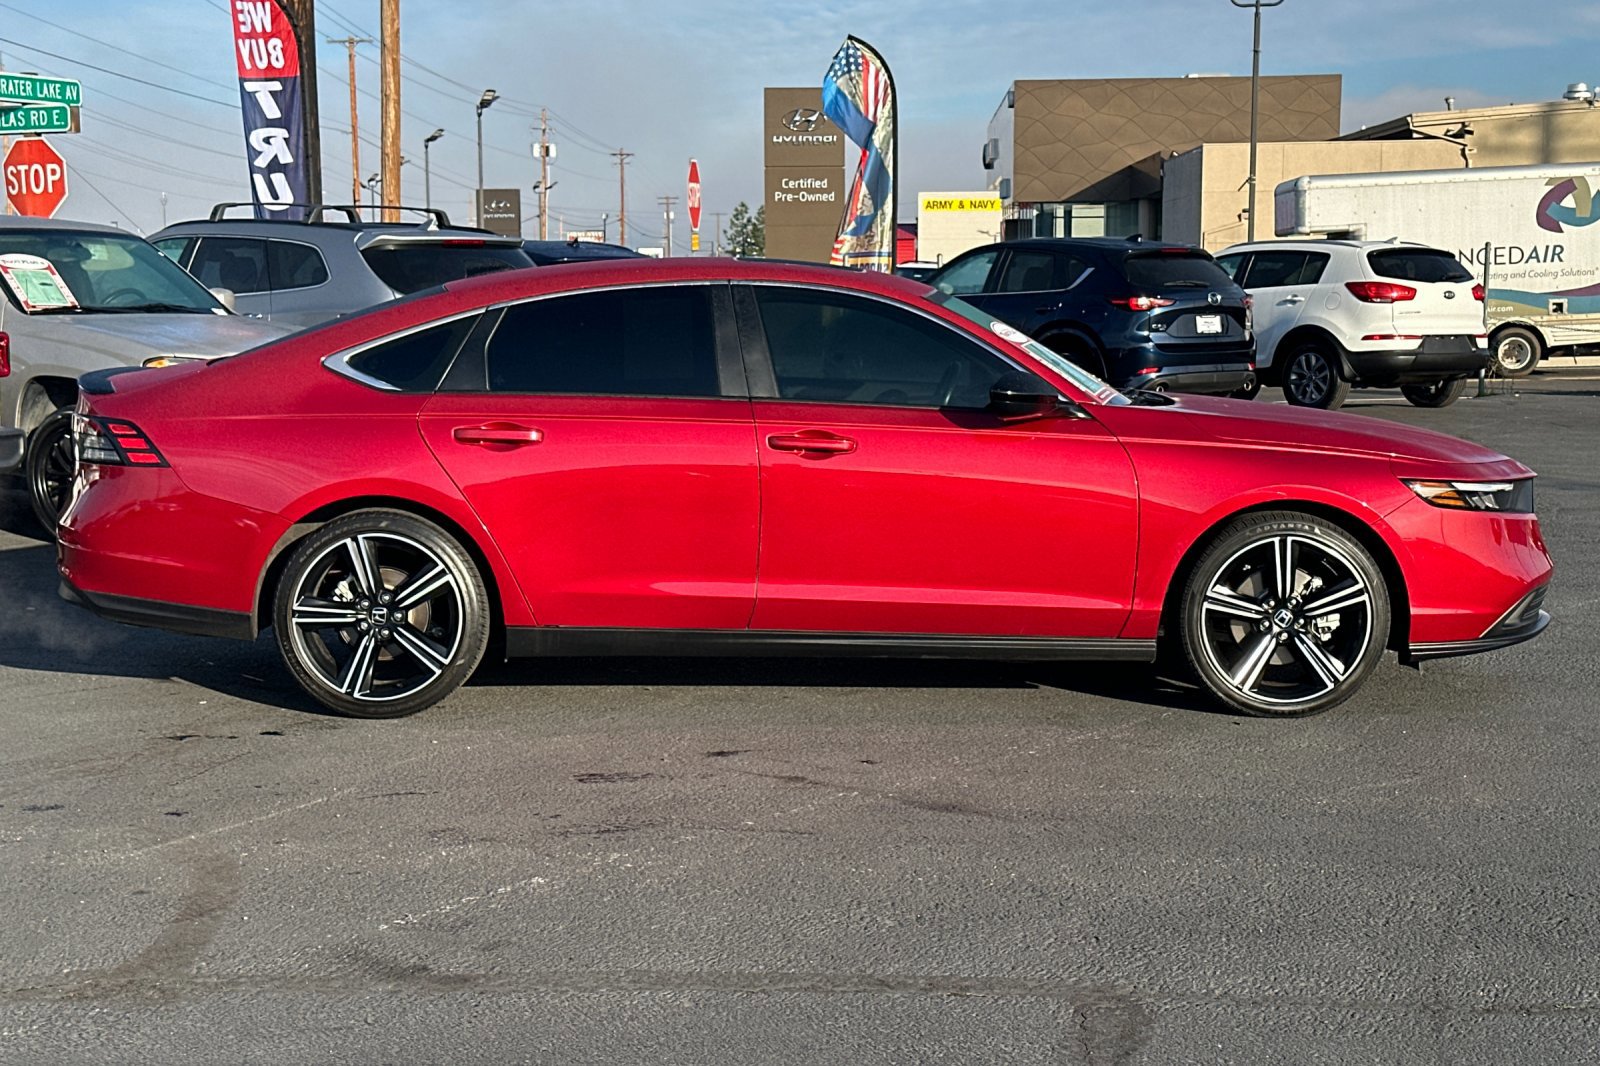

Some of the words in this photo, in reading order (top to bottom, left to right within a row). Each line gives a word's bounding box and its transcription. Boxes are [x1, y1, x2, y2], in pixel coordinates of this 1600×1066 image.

[37, 82, 62, 99] LAKE
[65, 85, 78, 101] AV
[0, 111, 26, 127] LAS
[30, 111, 48, 126] RD
[53, 110, 65, 125] E.
[7, 163, 61, 195] STOP
[781, 178, 828, 189] Certified
[774, 191, 835, 202] Pre-Owned
[925, 200, 954, 209] ARMY
[958, 200, 965, 209] &
[969, 200, 996, 209] NAVY
[1458, 244, 1565, 266] NCEDAIR
[1476, 271, 1508, 282] Hating
[1510, 270, 1526, 278] and
[1528, 269, 1560, 280] Cooling
[1256, 523, 1309, 534] ADVANTA
